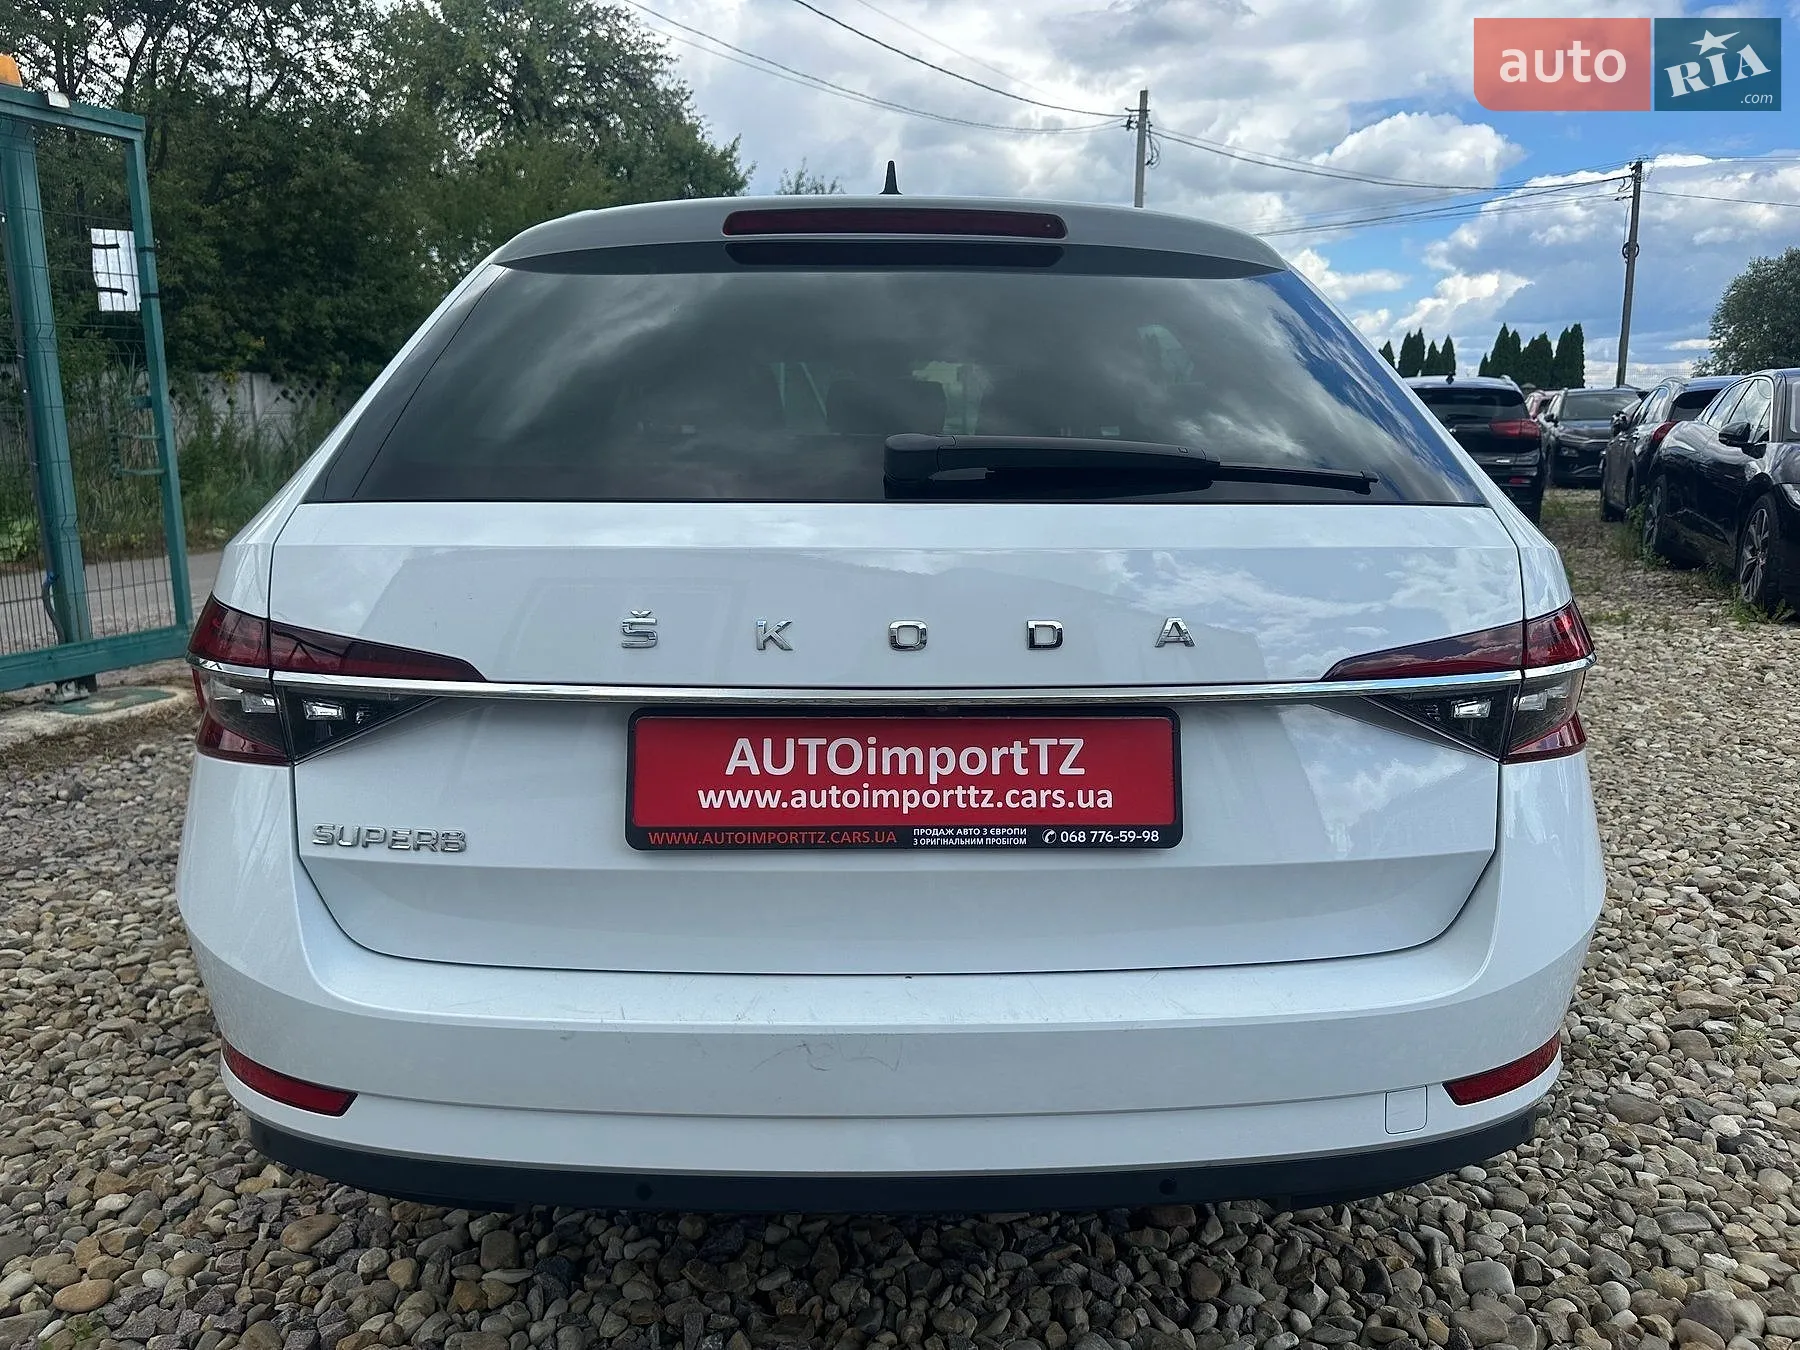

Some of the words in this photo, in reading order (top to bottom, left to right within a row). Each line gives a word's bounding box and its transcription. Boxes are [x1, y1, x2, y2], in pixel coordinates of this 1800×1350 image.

[621, 609, 1196, 651] ŠKODA
[725, 737, 1086, 784] AUTOimportTZ
[697, 783, 1114, 814] www.autoimporttz.cars.ua
[311, 823, 467, 852] SUPERB
[648, 831, 897, 845] WWW.AUTOIMPORTTZ.CARS.UA
[913, 828, 954, 837] ПРОДАЖ
[956, 828, 981, 836] АВТО
[990, 828, 1027, 836] ЄВРОПИ
[919, 837, 984, 846] ОРИГІНАЛЬНИМ
[986, 837, 1027, 846] ПРОБІГОМ
[1060, 831, 1086, 843] 068
[1089, 830, 1159, 843] 776-59-98
